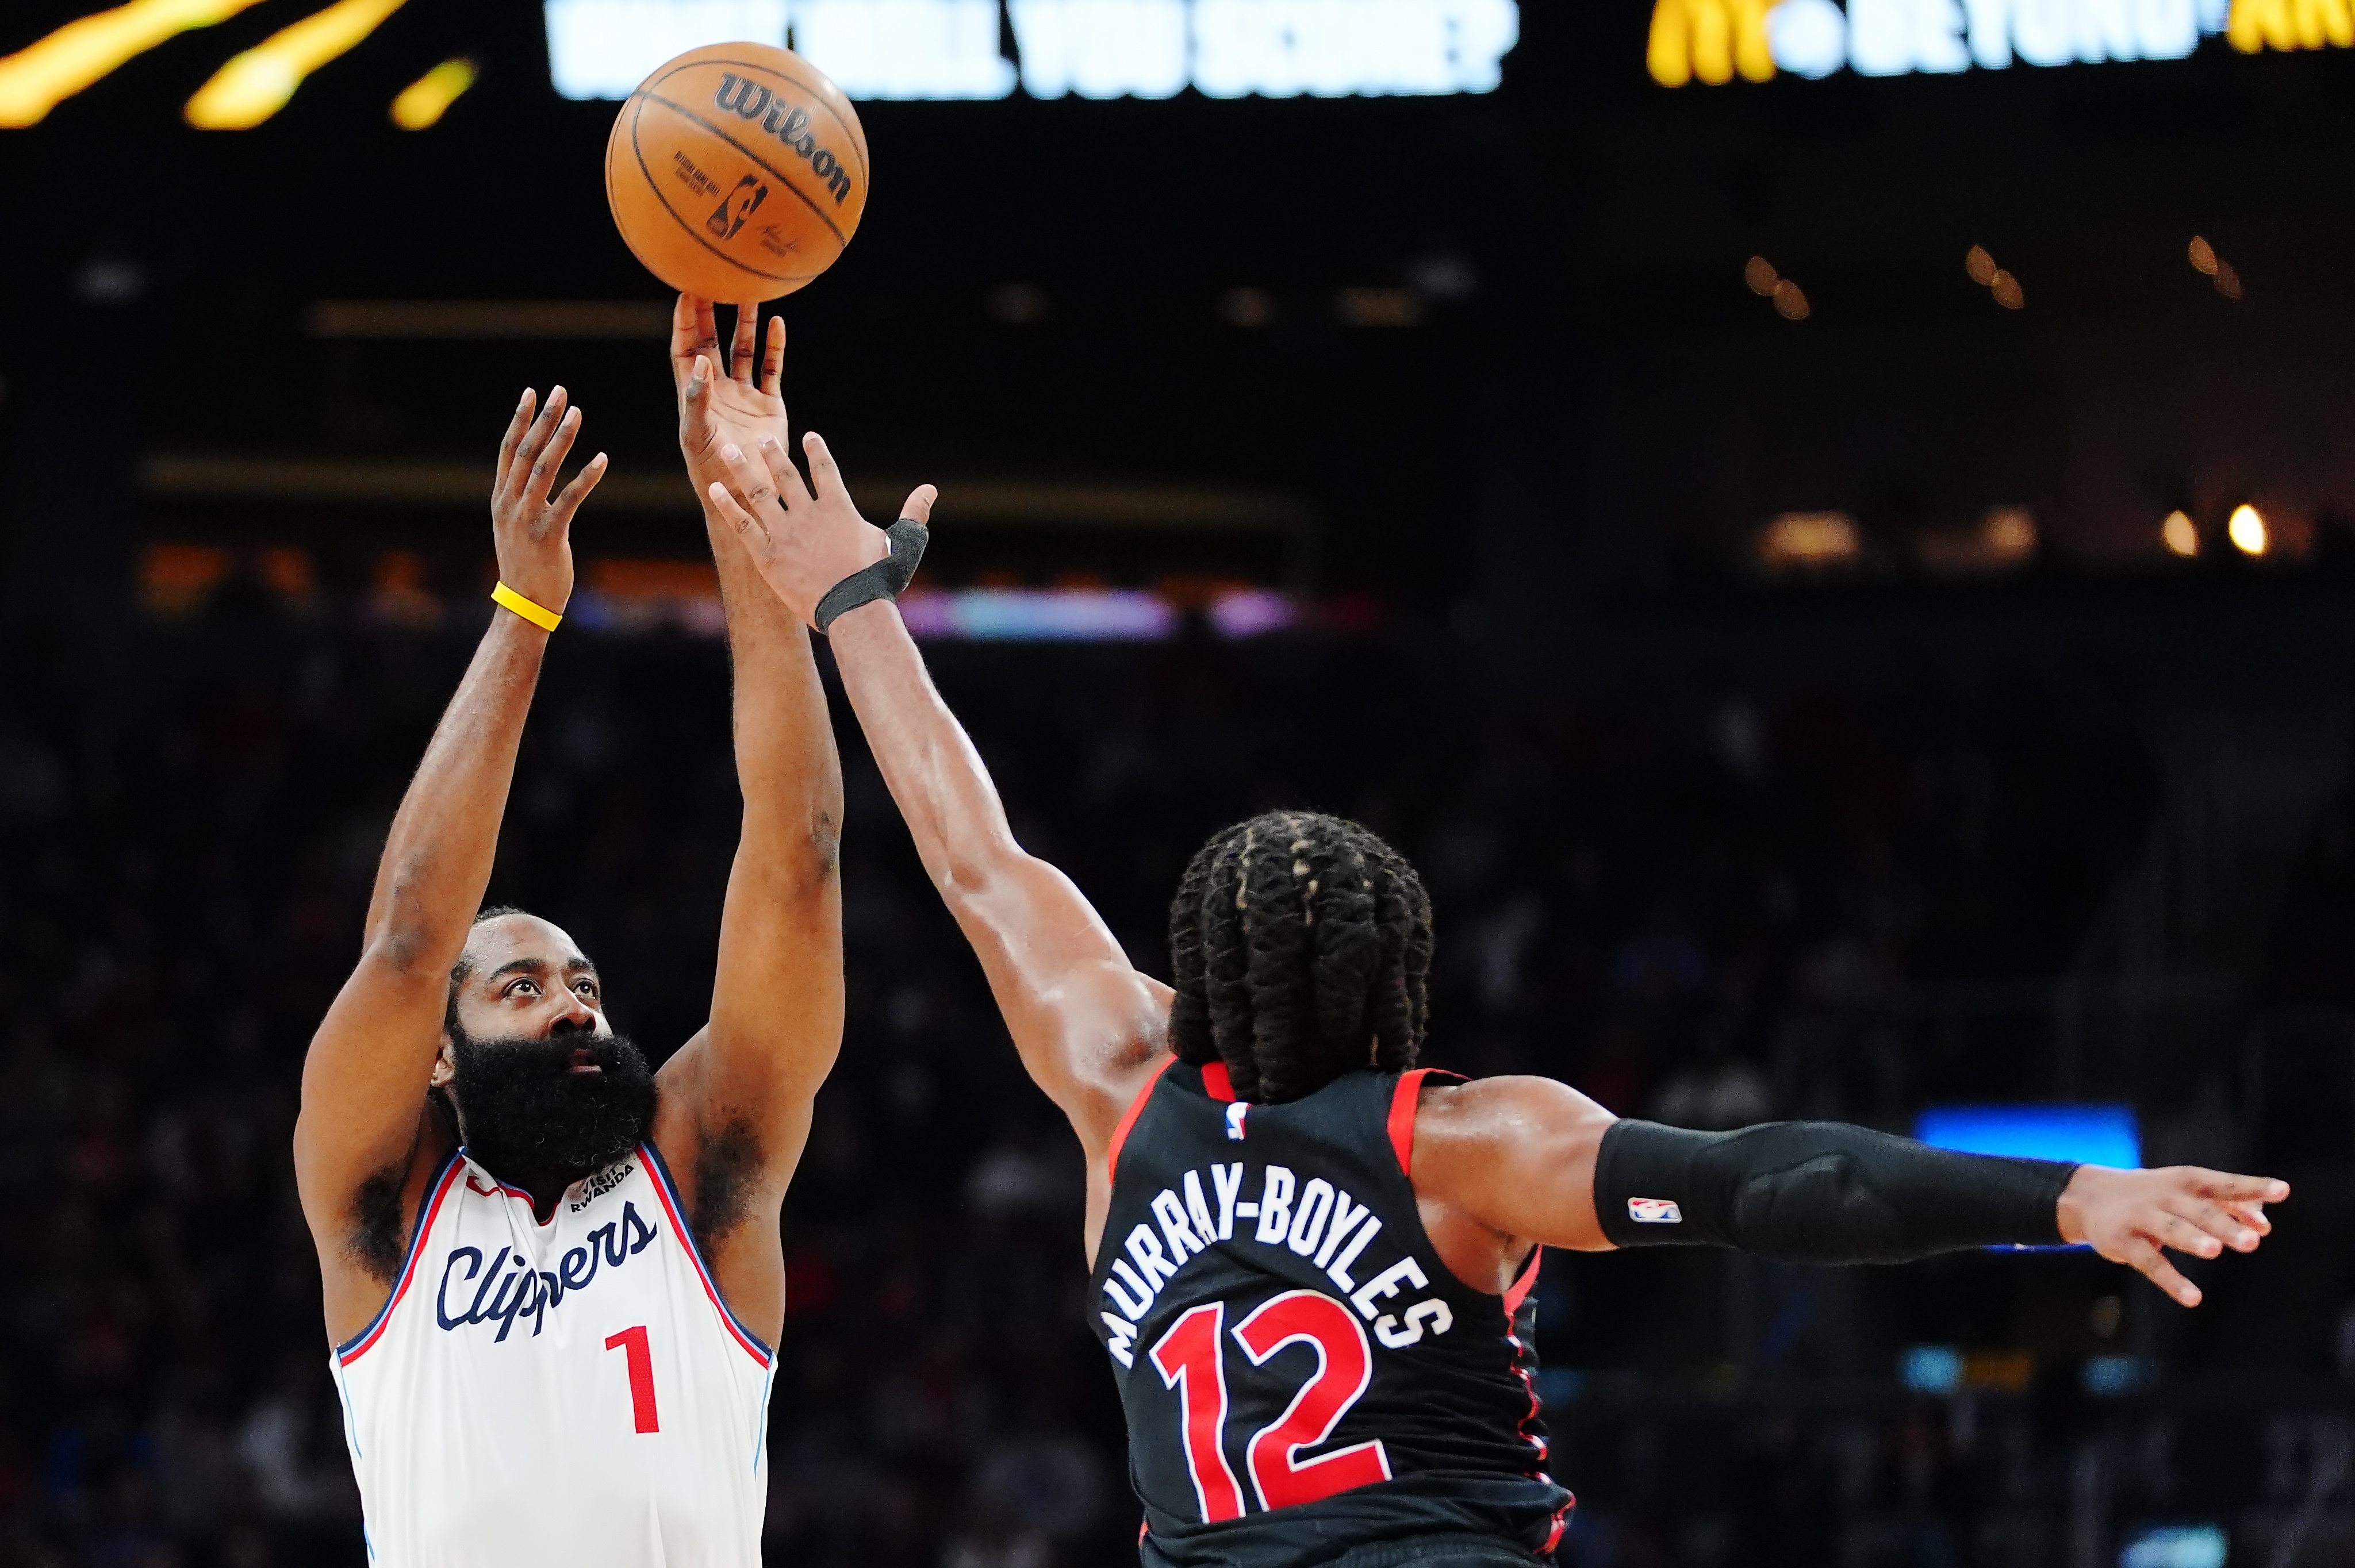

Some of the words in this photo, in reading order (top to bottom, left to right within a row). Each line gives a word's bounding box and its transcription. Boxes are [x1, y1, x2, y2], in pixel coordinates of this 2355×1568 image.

[714, 72, 852, 207] Wilson
[570, 1164, 634, 1213] RWANDA
[582, 1165, 617, 1194] VISIT
[436, 1200, 657, 1343] Clippers
[1100, 1162, 1453, 1370] MURRAY-BOYLES
[604, 1325, 659, 1434] 1
[1149, 1288, 1393, 1524] 12
